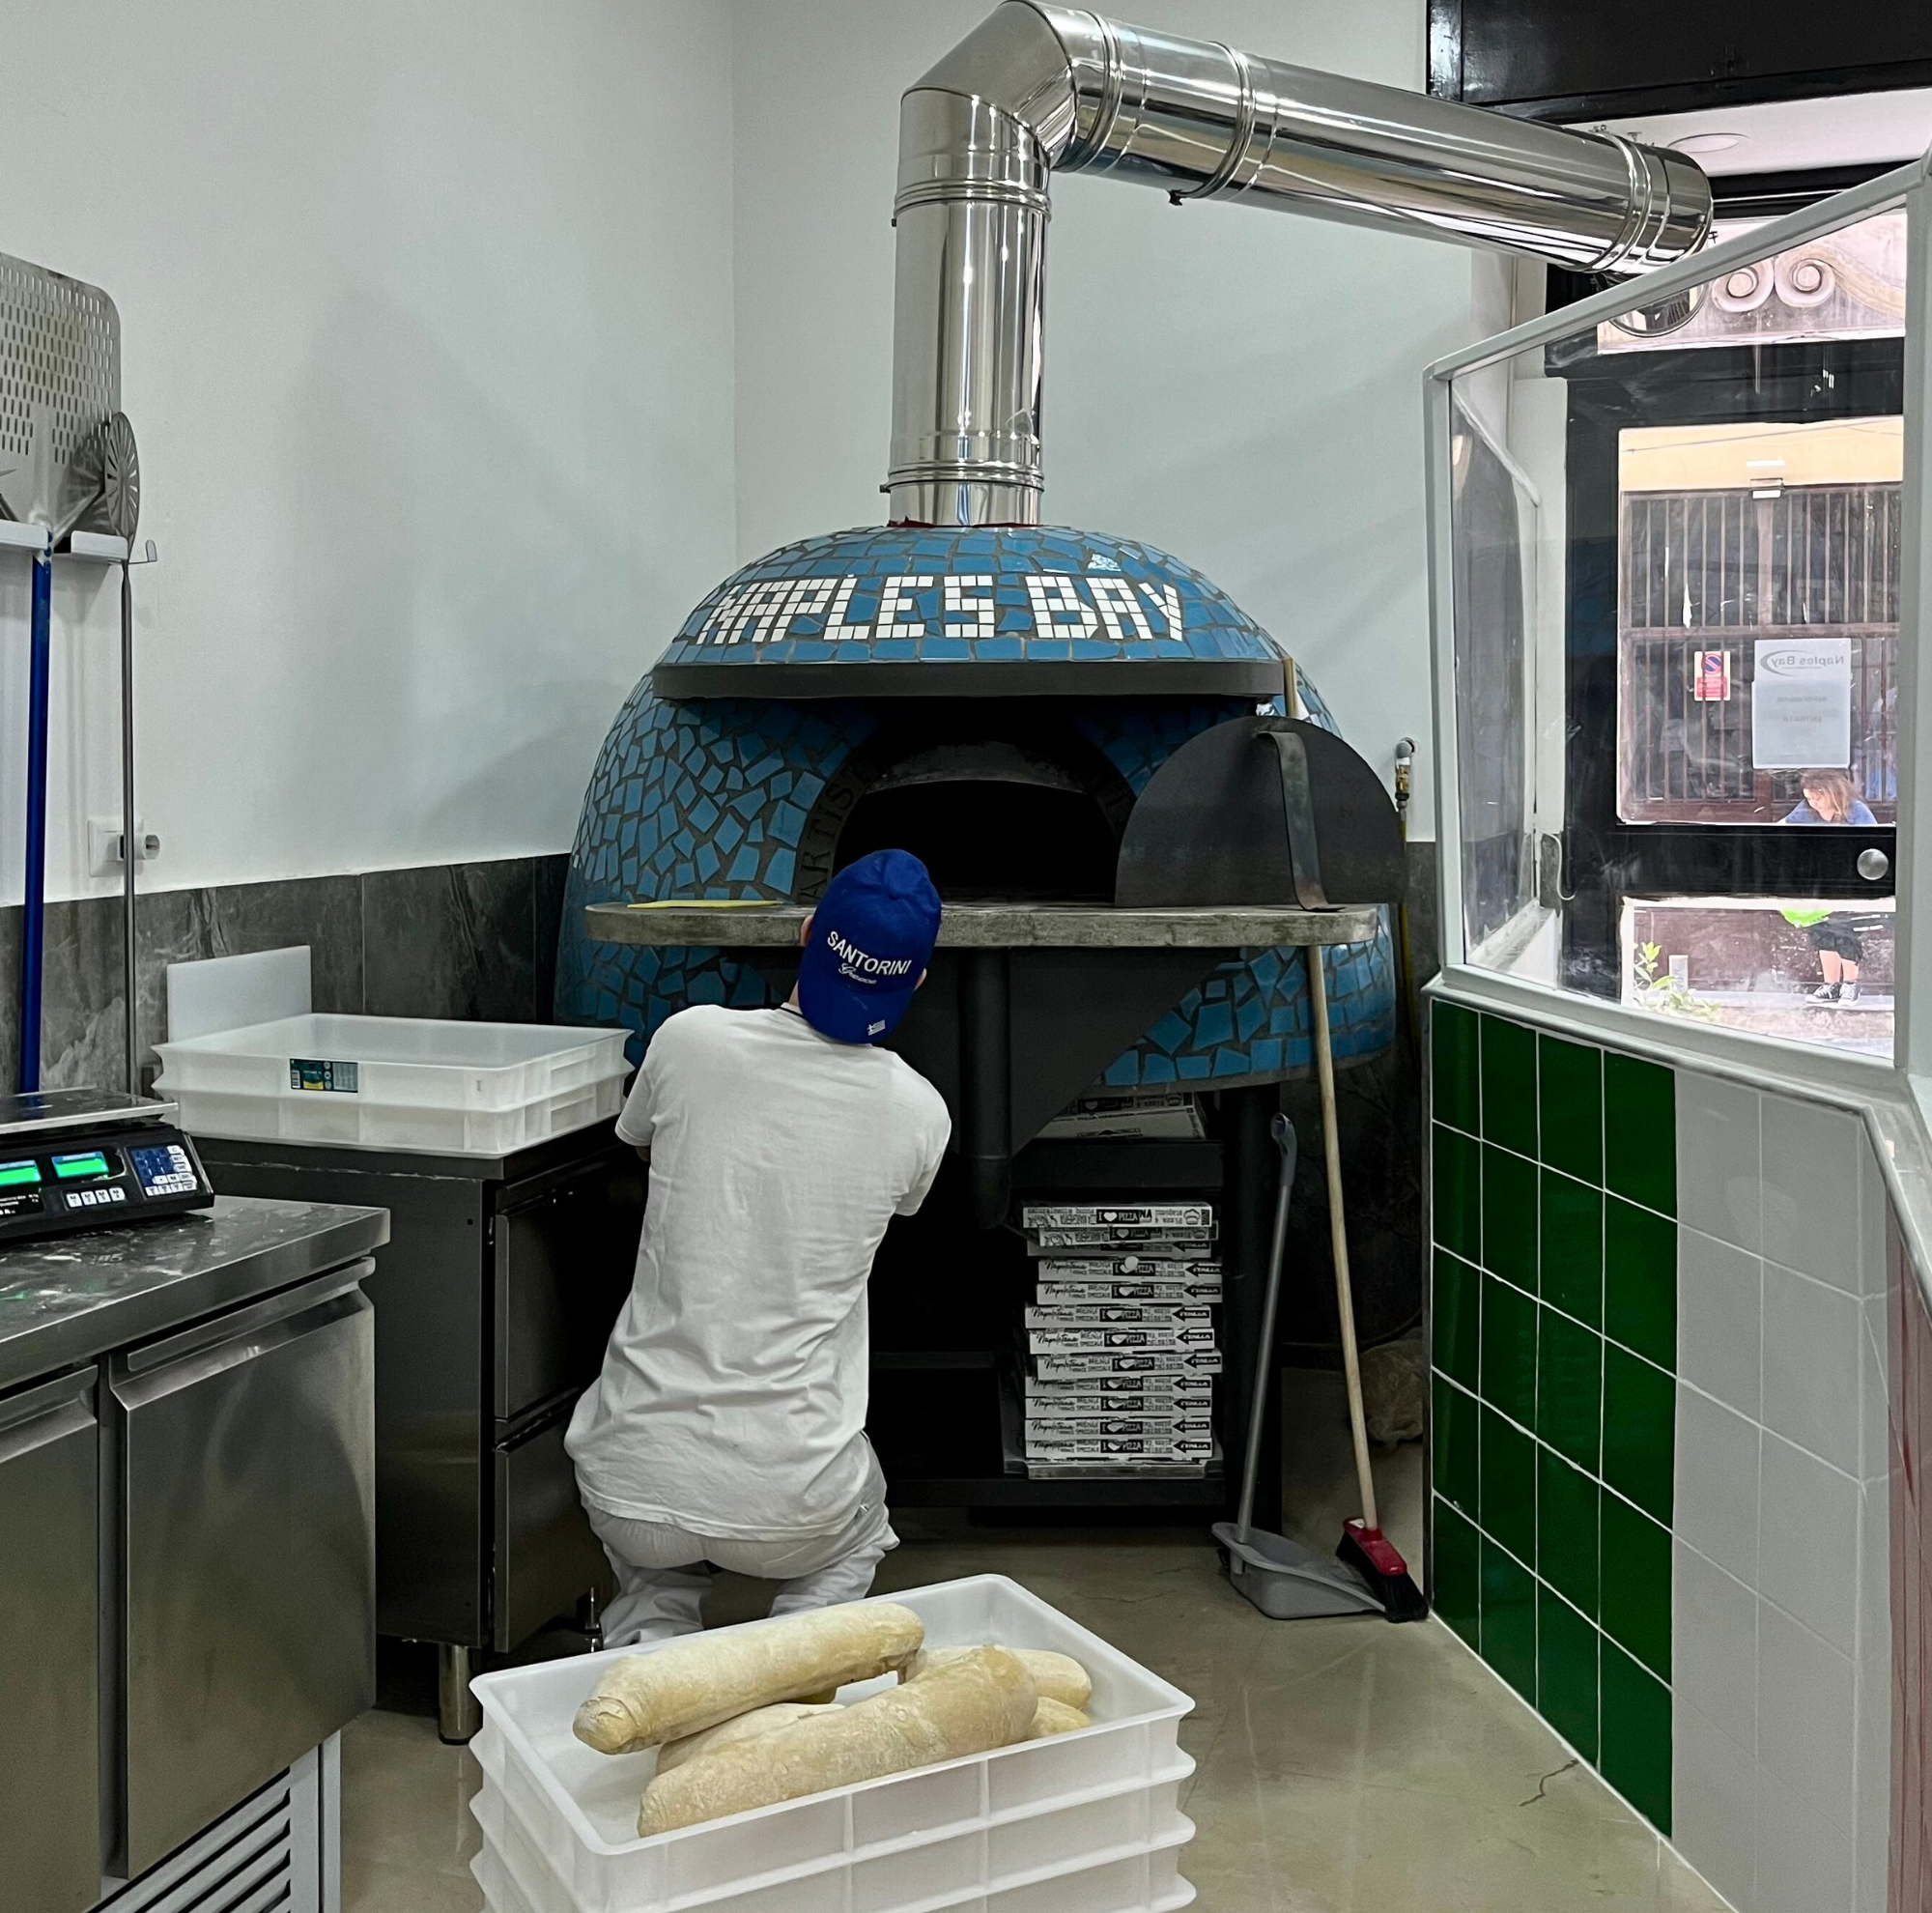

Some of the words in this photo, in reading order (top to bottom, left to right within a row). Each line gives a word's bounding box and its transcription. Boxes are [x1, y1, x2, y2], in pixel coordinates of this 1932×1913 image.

[696, 575, 995, 645] NAPLES
[1025, 575, 1182, 642] BAY
[827, 930, 912, 976] SANTORINI
[838, 962, 877, 985] Greece
[1118, 1212, 1138, 1221] PIZZA
